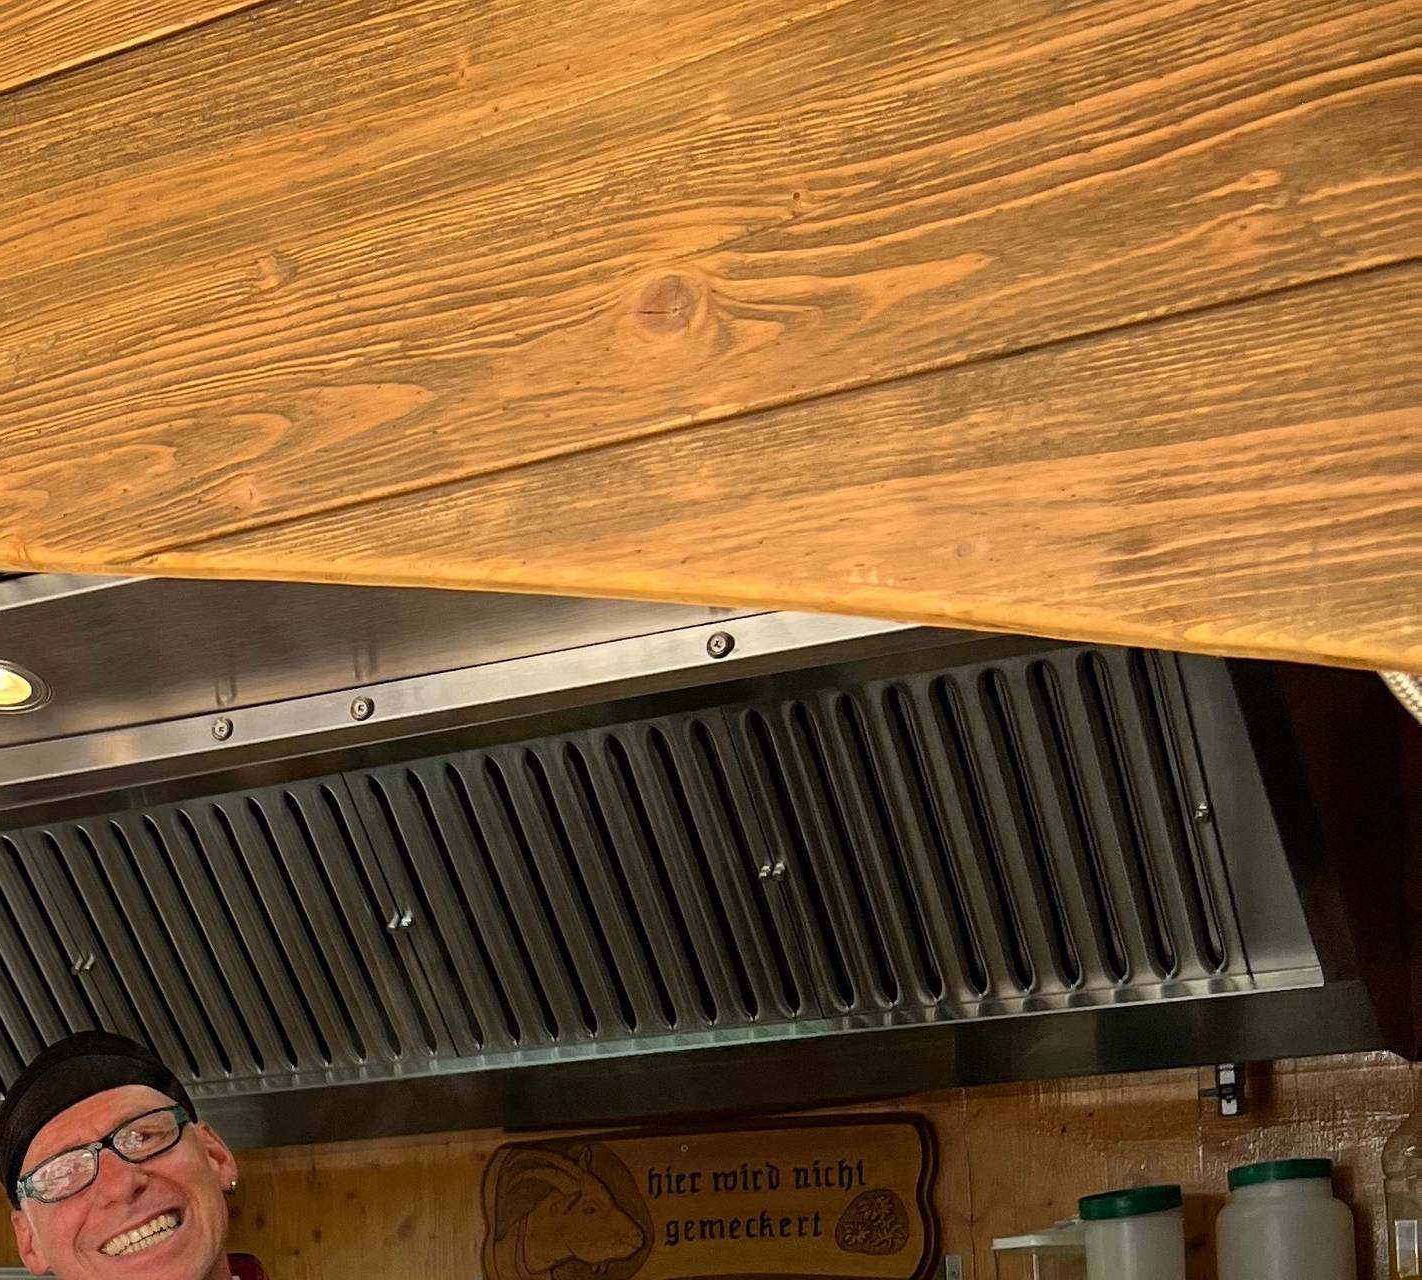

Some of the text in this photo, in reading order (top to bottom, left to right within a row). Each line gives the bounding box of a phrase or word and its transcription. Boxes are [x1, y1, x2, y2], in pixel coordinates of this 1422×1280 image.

[647, 1159, 866, 1198] hier wird nicht
[664, 1210, 822, 1246] gemeckert
